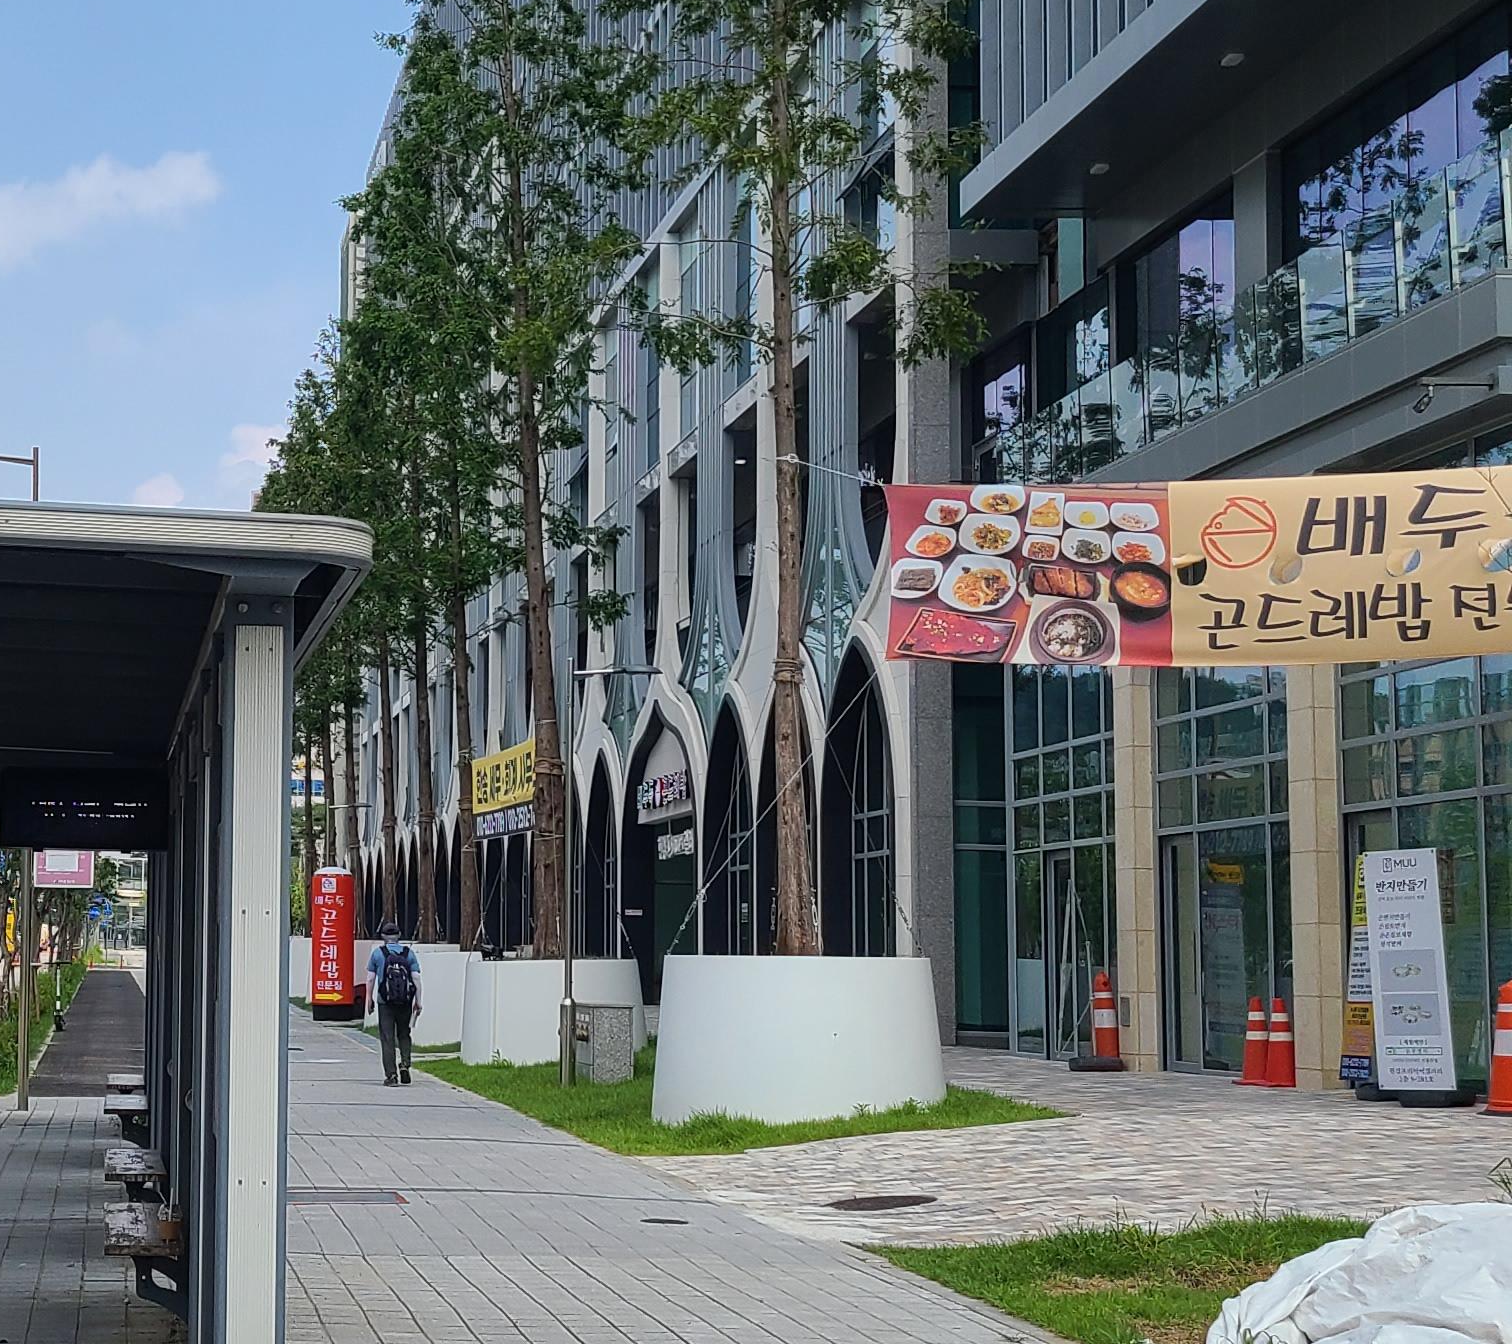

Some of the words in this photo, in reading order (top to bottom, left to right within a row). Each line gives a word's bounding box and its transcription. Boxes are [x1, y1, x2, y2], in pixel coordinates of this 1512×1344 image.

[1296, 483, 1512, 557] 배두
[1197, 582, 1432, 650] 곤드레밥
[1449, 583, 1512, 632] 전
[517, 751, 535, 793] 사무
[1375, 877, 1428, 893] 반지만들기
[1393, 857, 1417, 869] MUU
[320, 907, 339, 979] 곤드레밥
